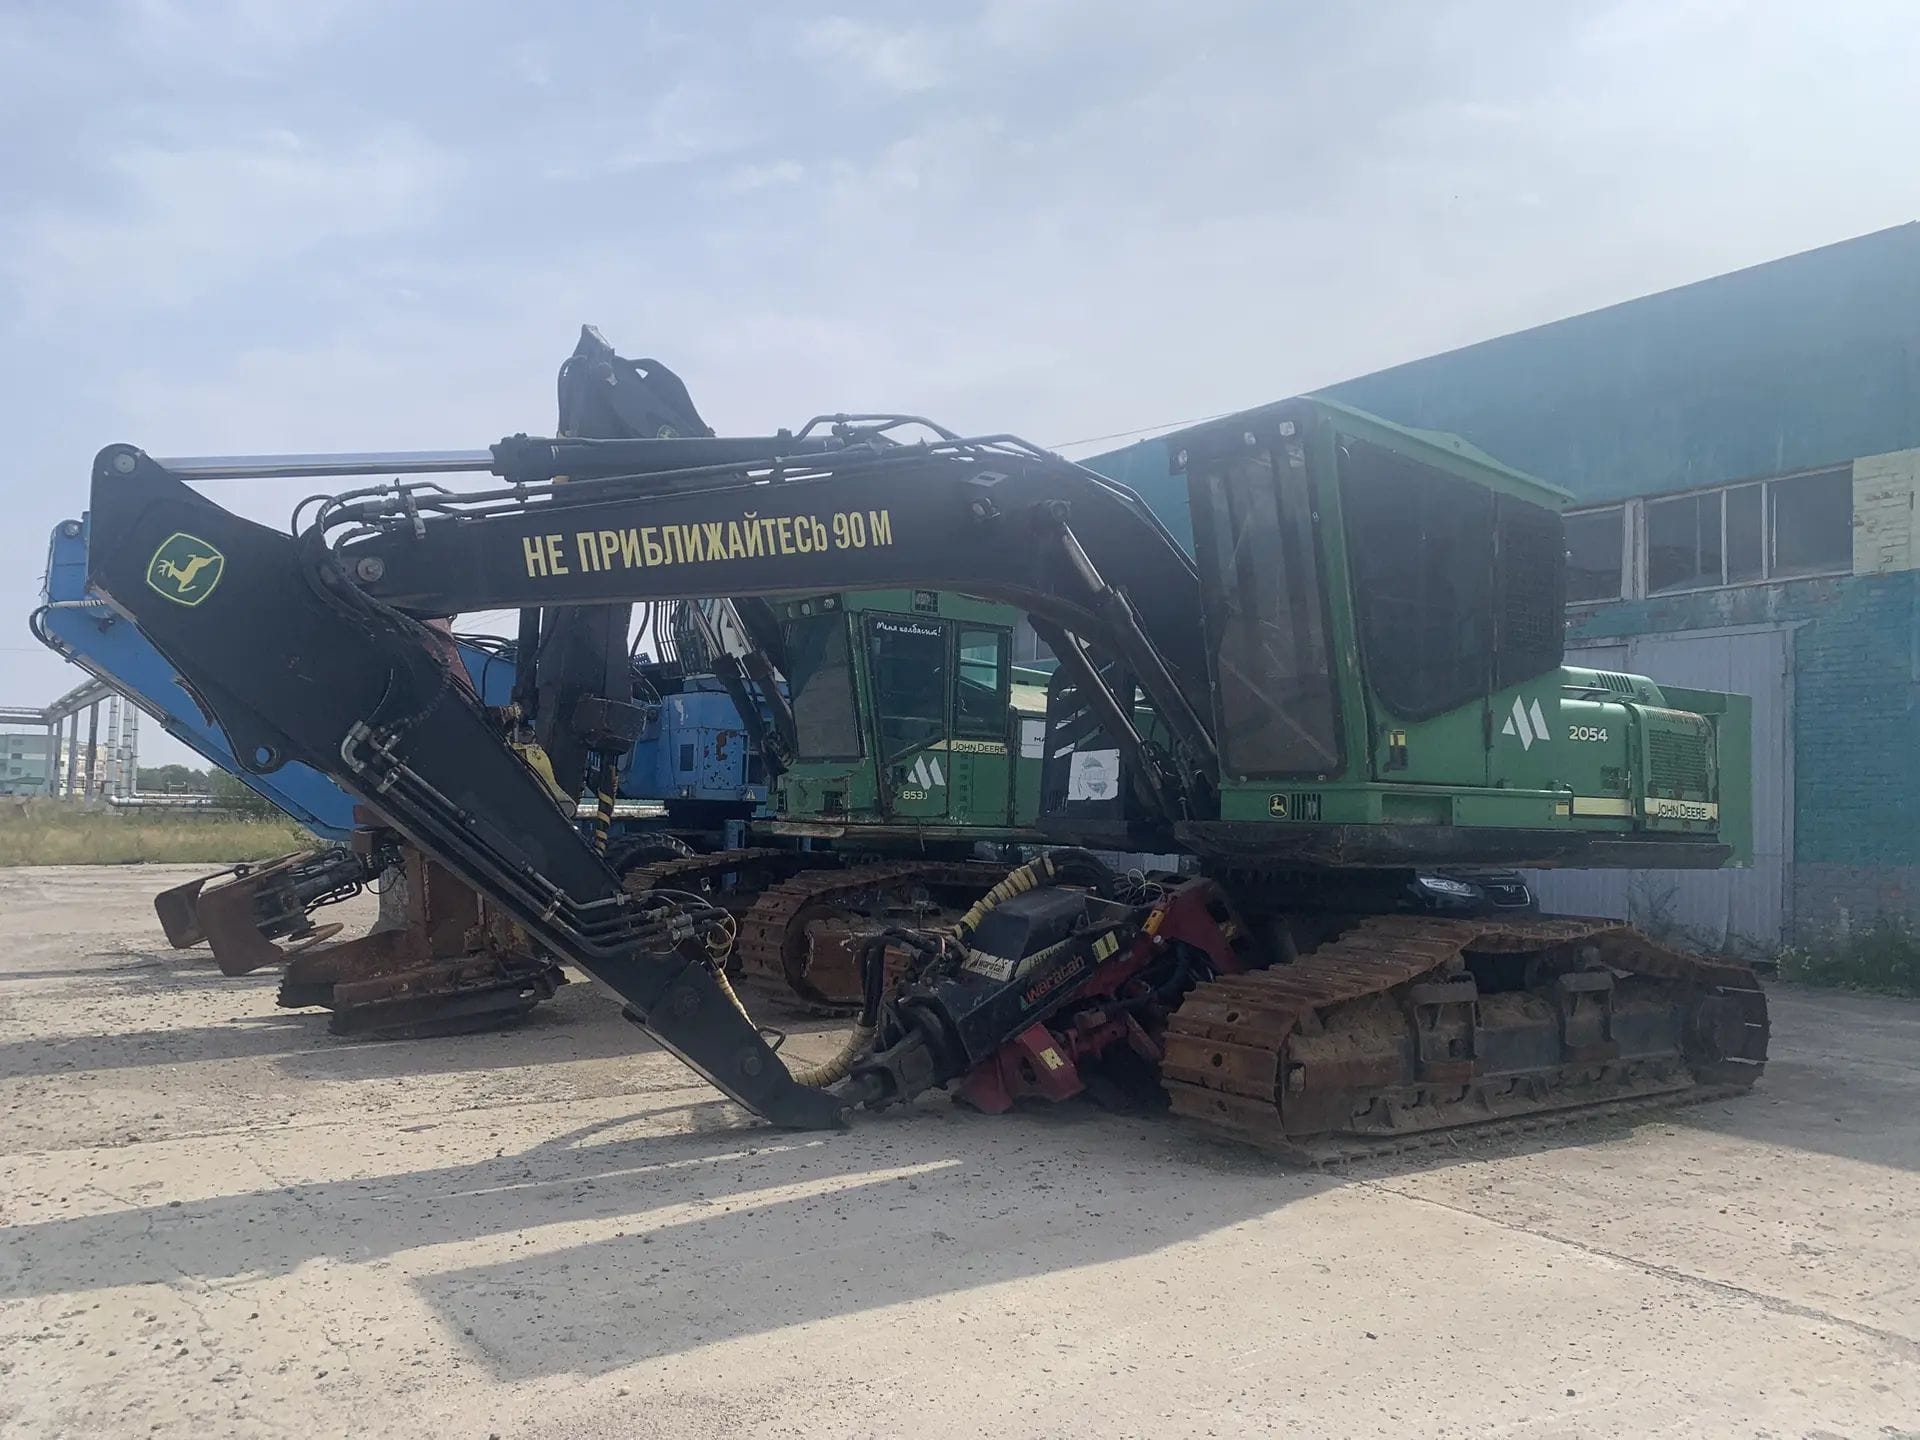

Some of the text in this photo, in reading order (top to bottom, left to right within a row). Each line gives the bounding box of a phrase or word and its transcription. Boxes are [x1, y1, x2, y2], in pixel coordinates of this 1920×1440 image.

[522, 510, 893, 578] НЕ ПРИБЛИЖАЙТЕСЬ 90 М
[1568, 725, 1609, 742] 2054
[952, 741, 1006, 754] JOHN DEERE
[1656, 801, 1708, 819] JOHN DEERE
